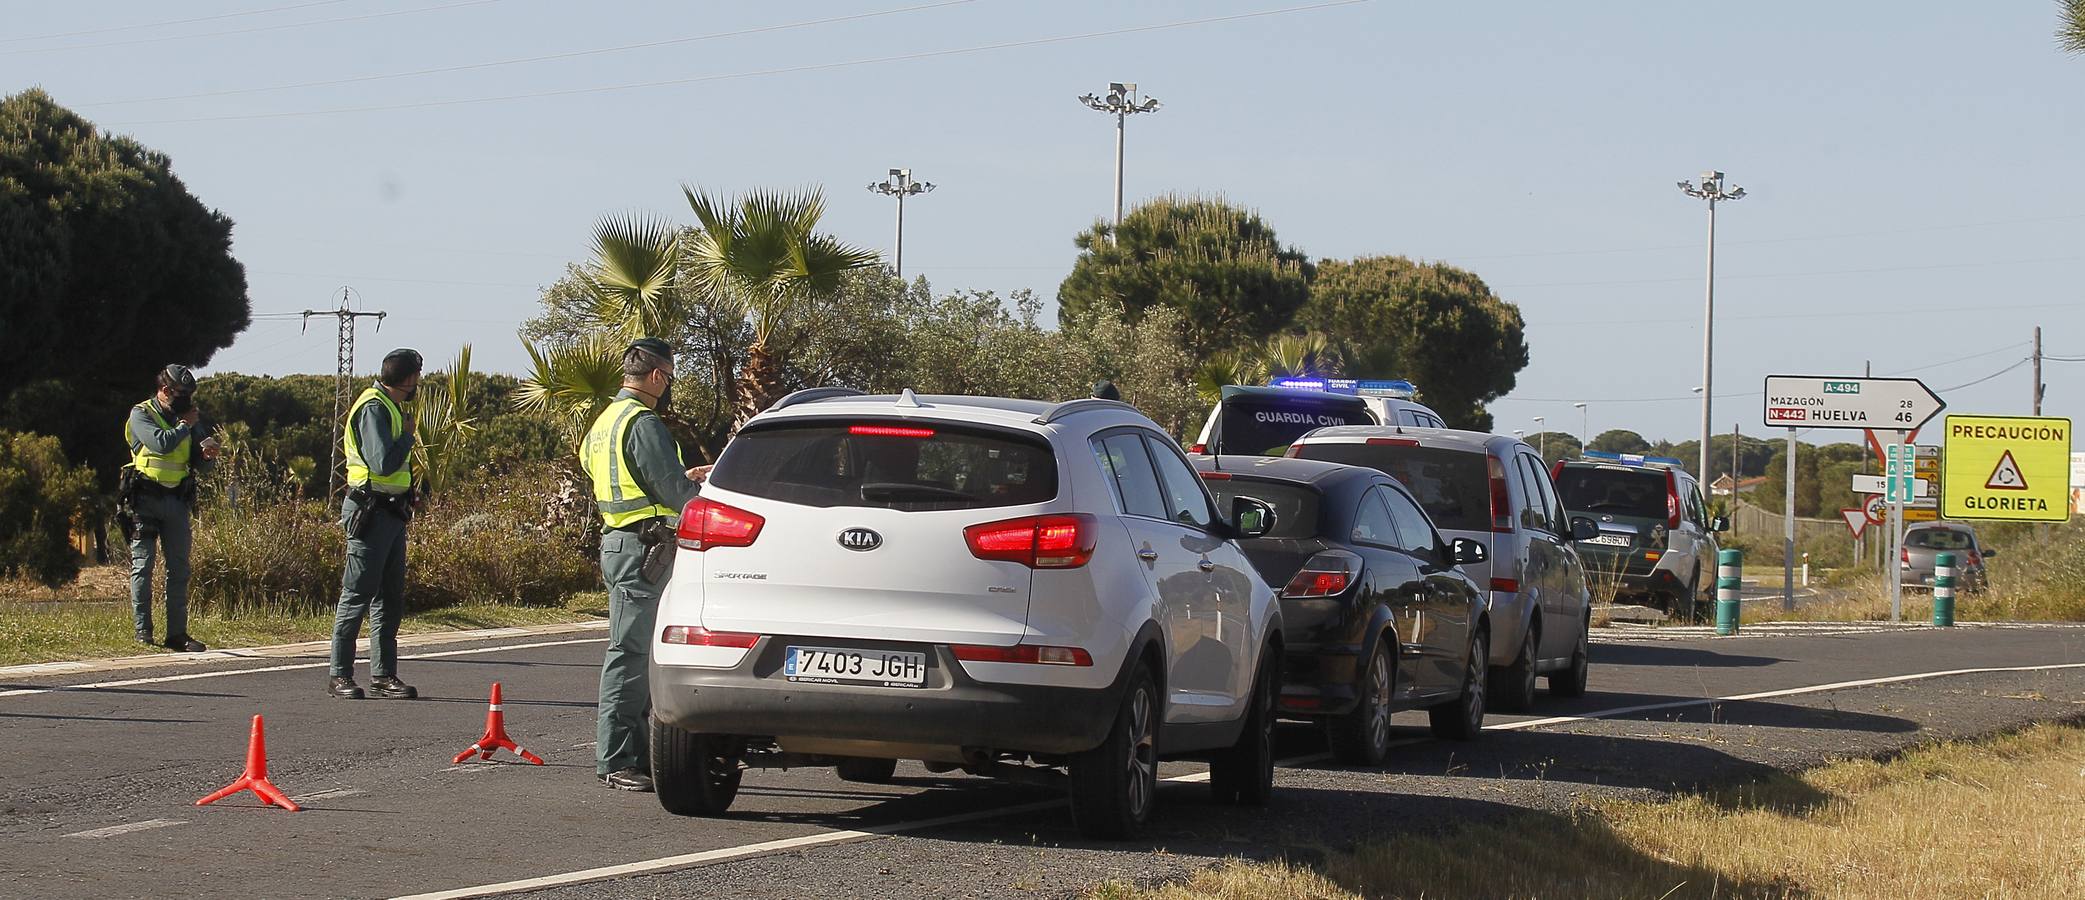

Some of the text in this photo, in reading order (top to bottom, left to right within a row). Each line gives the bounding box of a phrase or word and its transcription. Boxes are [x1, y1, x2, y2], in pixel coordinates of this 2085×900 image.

[1825, 383, 1859, 393] A-494
[1770, 396, 1913, 409] MAZAGÓN 28
[1256, 411, 1315, 425] GUARDIA
[1770, 409, 1913, 423] N-442 HUELVA 46
[1953, 425, 2064, 441] PRECAUCIÓN
[1965, 496, 2048, 511] GLORIETA
[844, 531, 875, 546] KIA
[788, 650, 918, 679] E 7403 JGH
